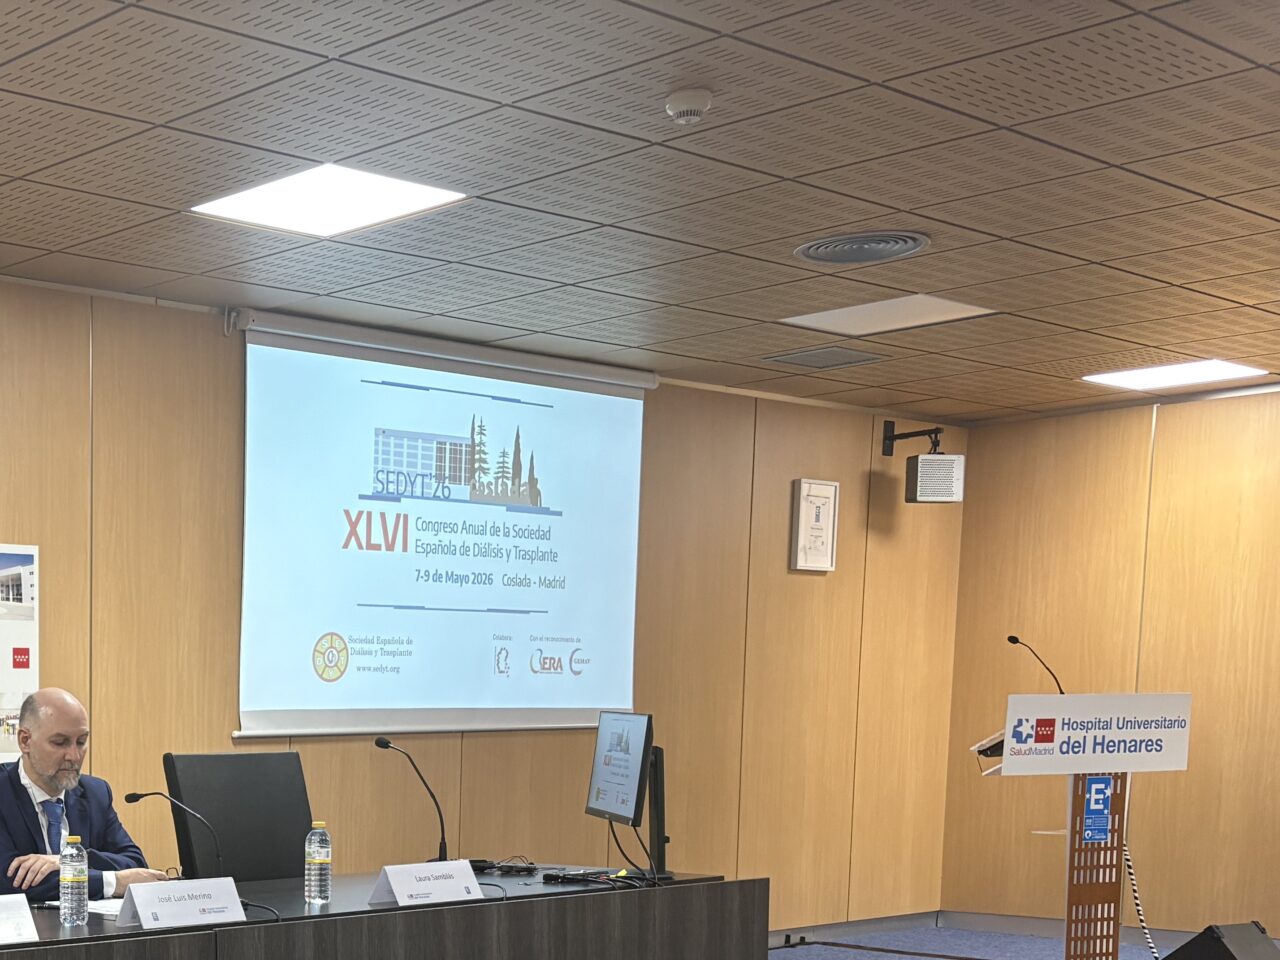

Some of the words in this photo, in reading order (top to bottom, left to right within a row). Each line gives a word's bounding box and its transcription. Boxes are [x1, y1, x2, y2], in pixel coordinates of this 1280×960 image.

[342, 509, 409, 553] XLVI
[415, 517, 458, 536] Congreso
[461, 520, 487, 537] Anual
[490, 521, 500, 537] de
[503, 522, 510, 538] la
[512, 524, 551, 541] Sociedad
[415, 539, 457, 558] Española
[459, 540, 471, 557] de
[473, 542, 503, 559] Diálisis
[505, 548, 511, 563] y
[513, 545, 558, 564] Trasplante
[415, 569, 431, 583] 7-9
[432, 569, 443, 583] de
[445, 570, 470, 587] Mayo
[471, 572, 494, 586] 2026
[501, 574, 531, 588] Coslada
[539, 575, 566, 590] Madrid
[348, 635, 375, 645] Sociedad
[376, 635, 405, 646] Española
[405, 636, 413, 645] de
[374, 649, 378, 658] y
[380, 647, 413, 658] Trasplante
[356, 663, 401, 674] www.sedyt.org
[541, 657, 563, 671] ERA
[1061, 716, 1112, 733] Hospital
[1117, 715, 1187, 730] Universitario
[1009, 746, 1054, 757] SaludMadrid
[1059, 735, 1087, 755] del
[1092, 735, 1163, 754] Henares
[1089, 783, 1106, 810] E
[414, 873, 431, 882] Laura
[157, 893, 173, 903] José
[174, 893, 186, 902] Luis
[187, 892, 212, 902] Merino
